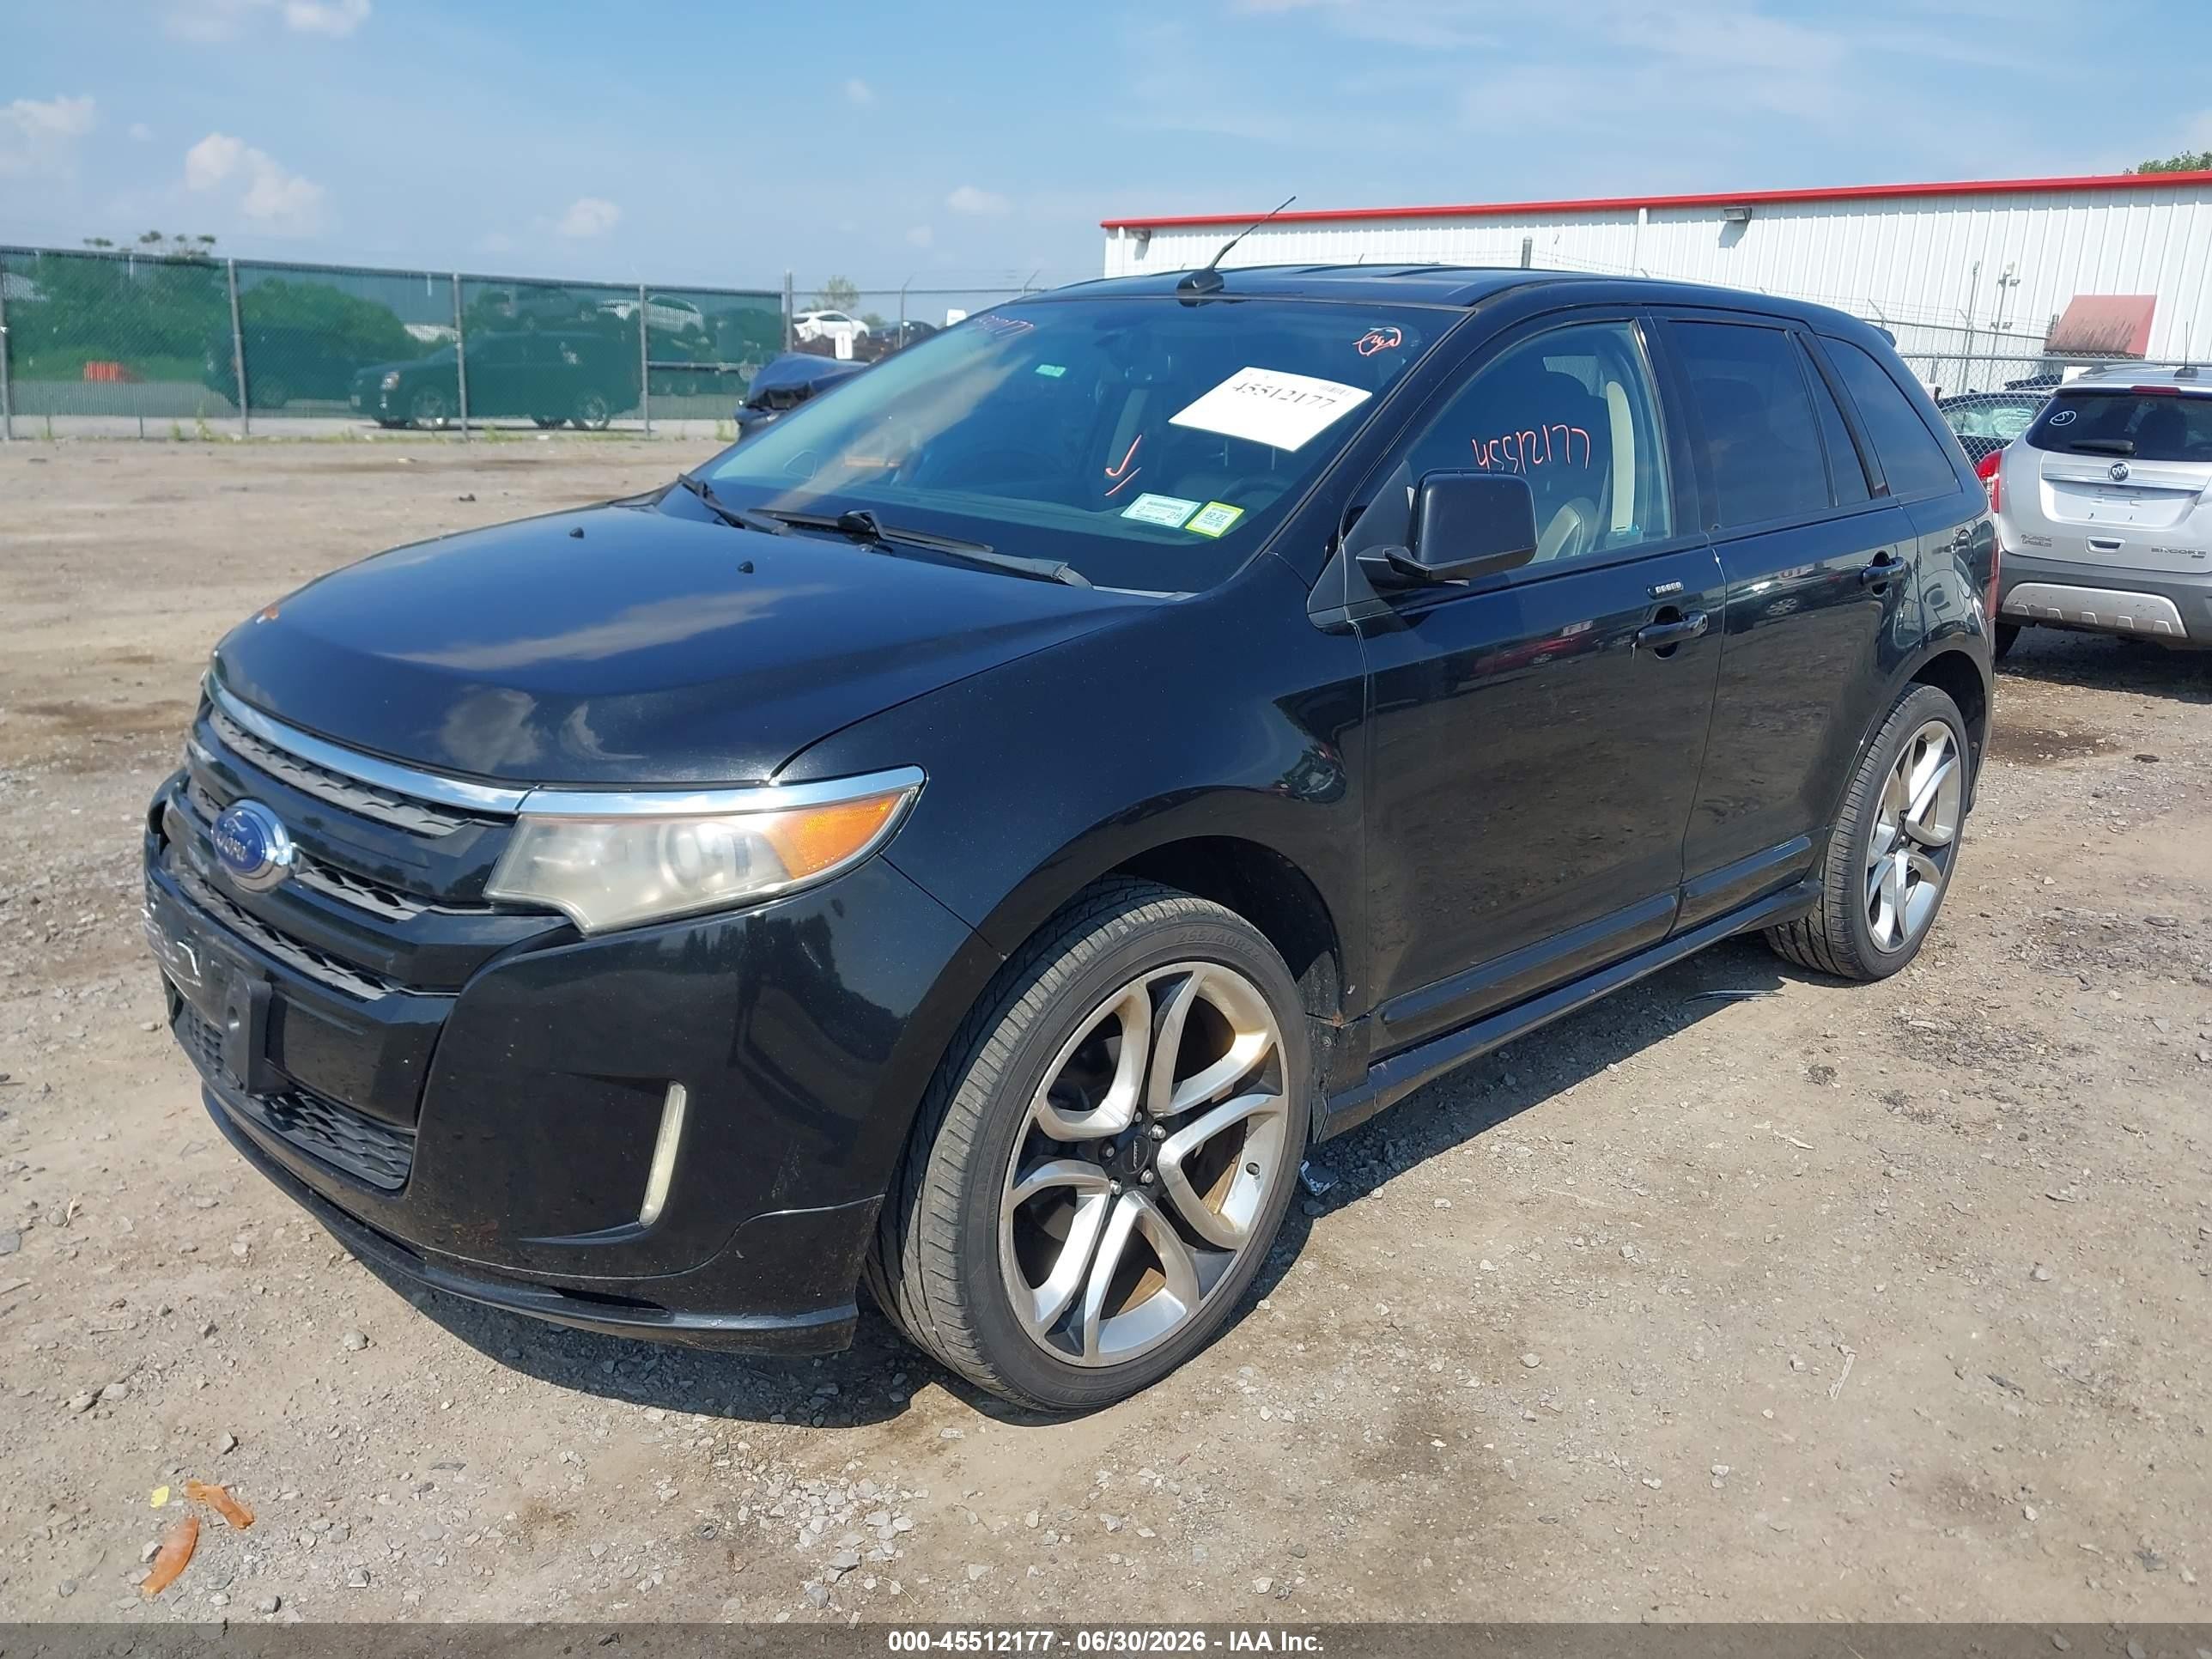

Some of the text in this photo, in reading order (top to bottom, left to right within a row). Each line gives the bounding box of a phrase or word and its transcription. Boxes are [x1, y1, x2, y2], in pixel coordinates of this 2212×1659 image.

[1232, 382, 1337, 409] 45512177
[1471, 424, 1590, 475] 45512177
[2150, 546, 2207, 556] ENCORE
